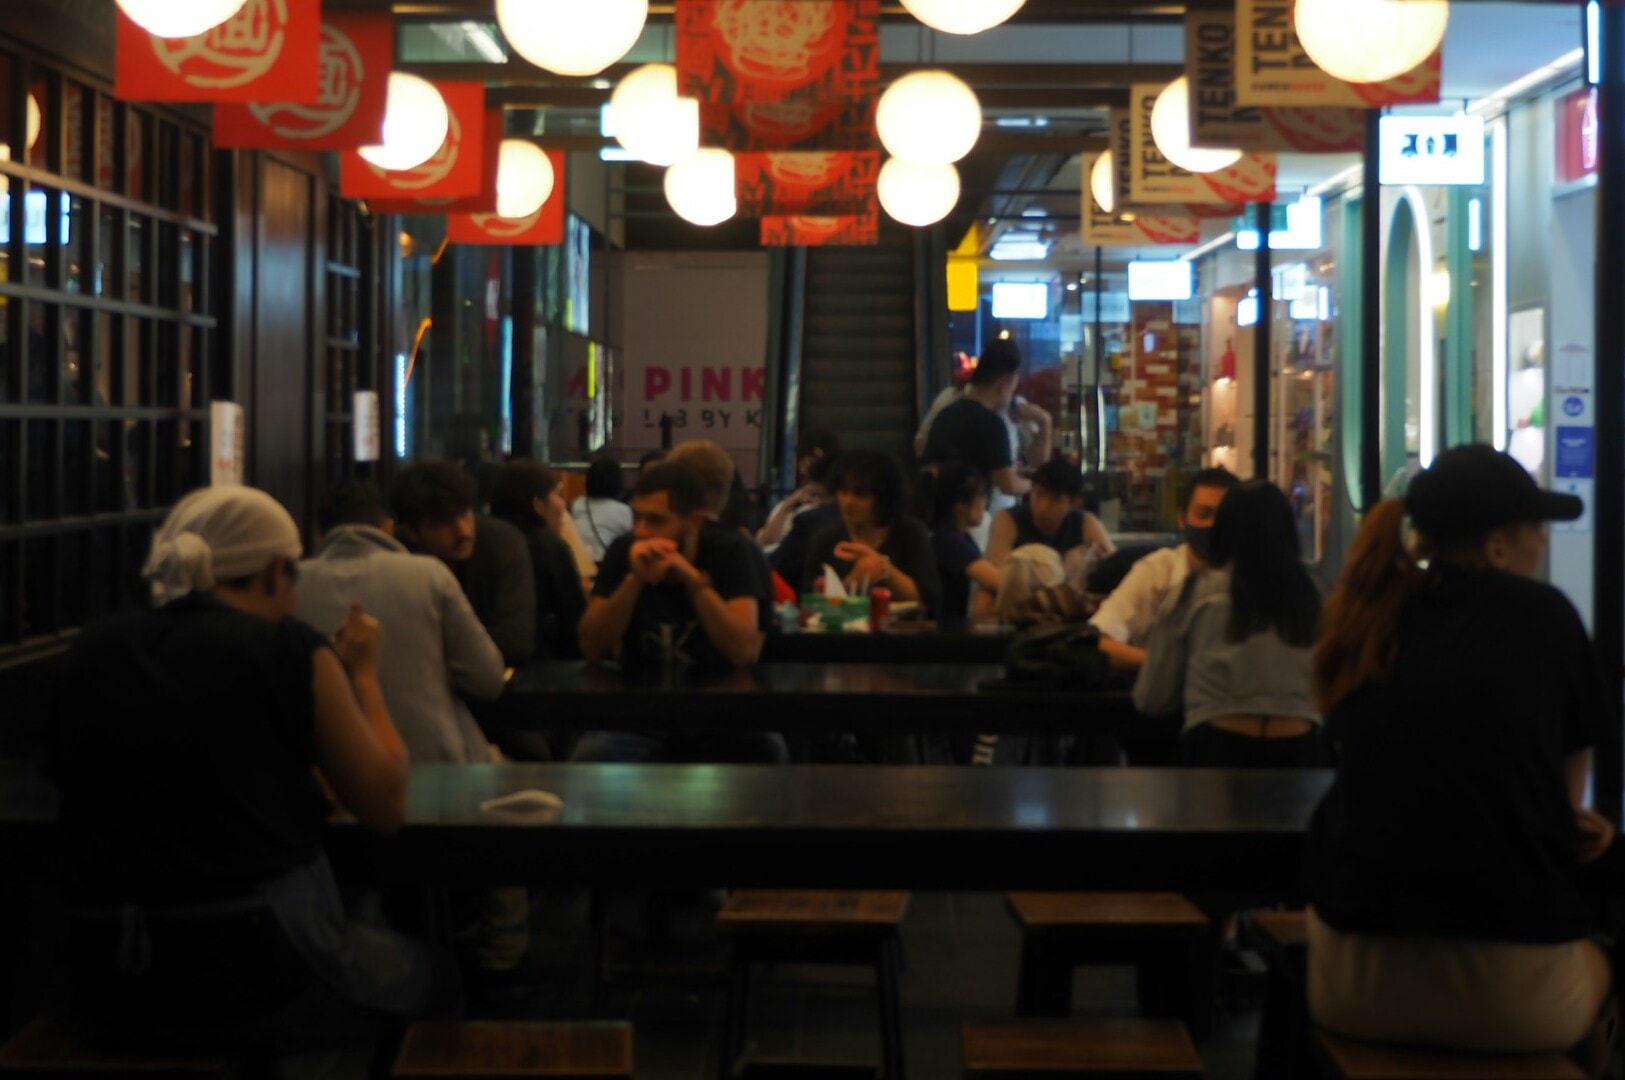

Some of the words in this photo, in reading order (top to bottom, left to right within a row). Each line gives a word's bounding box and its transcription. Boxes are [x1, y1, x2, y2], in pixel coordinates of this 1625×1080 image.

[1252, 0, 1288, 75] TEN
[1197, 23, 1229, 127] TENKO
[645, 366, 766, 401] PINK
[701, 409, 731, 428] BY
